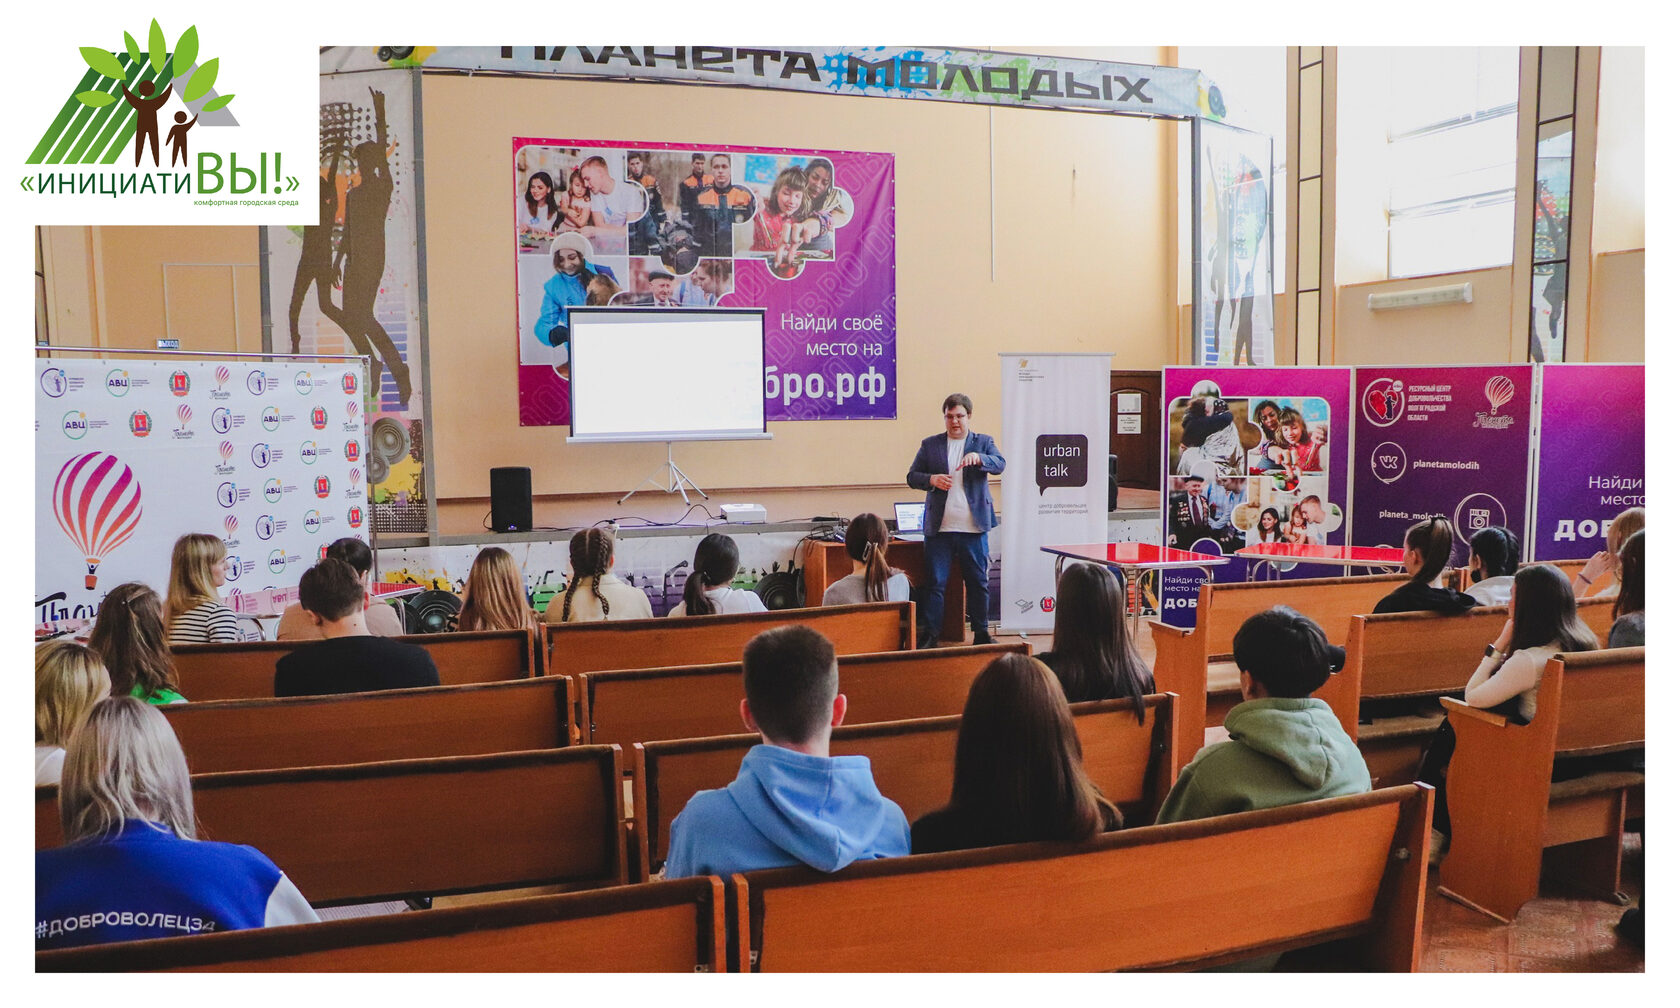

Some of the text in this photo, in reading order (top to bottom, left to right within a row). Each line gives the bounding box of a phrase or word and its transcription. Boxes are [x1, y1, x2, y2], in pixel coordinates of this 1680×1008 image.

[847, 55, 1154, 103] МОЛОДЫХ
[781, 313, 883, 333] Найди своё
[806, 343, 883, 355] место на
[765, 366, 886, 406] бро.рф
[1043, 444, 1081, 457] urban
[1044, 464, 1069, 477] talk
[1413, 460, 1480, 470] planetamolodih
[1589, 475, 1642, 491] Найди
[1600, 495, 1645, 506] место
[1554, 519, 1615, 541] ДОБ
[1164, 576, 1193, 584] Найди
[1164, 598, 1198, 610] ДОБ
